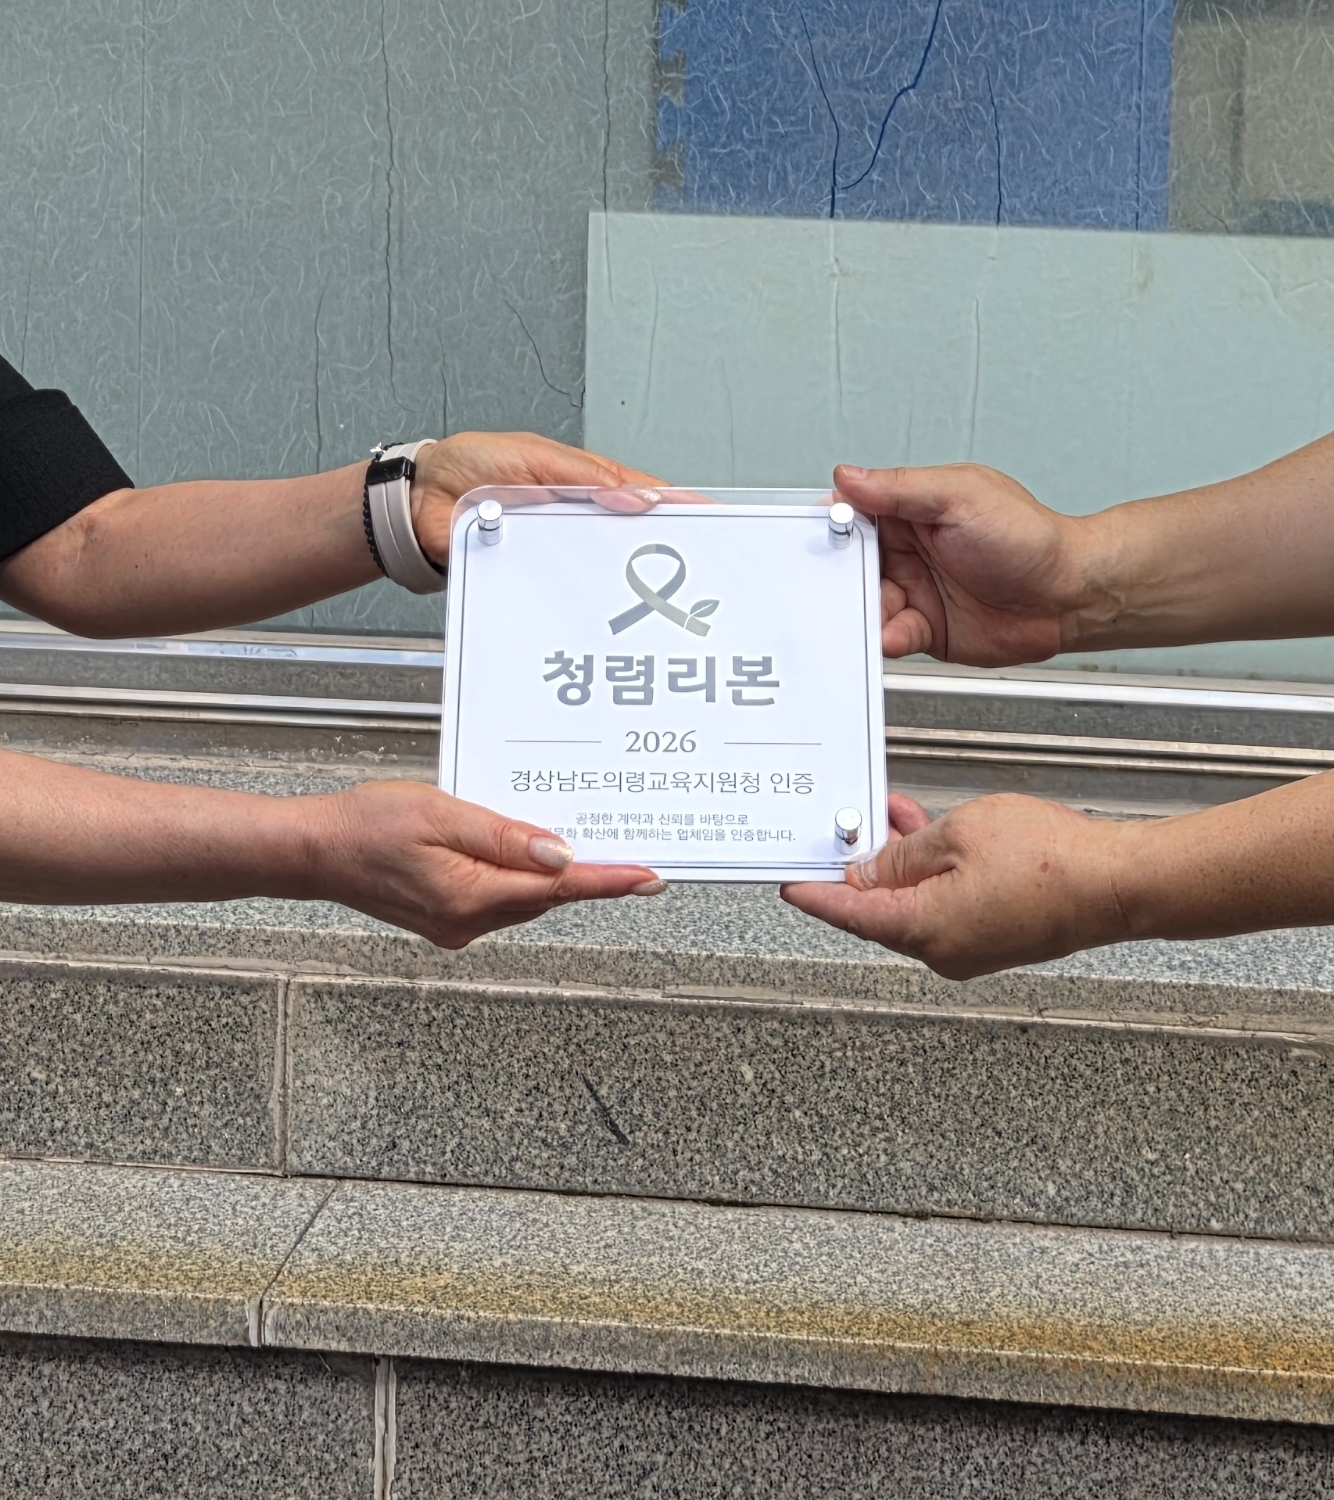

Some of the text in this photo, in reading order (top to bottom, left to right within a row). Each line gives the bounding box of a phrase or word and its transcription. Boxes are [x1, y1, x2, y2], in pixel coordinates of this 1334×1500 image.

[542, 649, 780, 706] 청렴리본
[625, 729, 697, 754] 2026
[510, 769, 815, 795] 경상남도의령교육지원청 인증
[575, 812, 749, 826] 공정한 계약과 신뢰를 바탕으로
[582, 827, 618, 840] 확산에
[624, 827, 672, 841] 함께하는
[677, 828, 726, 841] 업체임을
[730, 828, 796, 842] 인증합니다.
